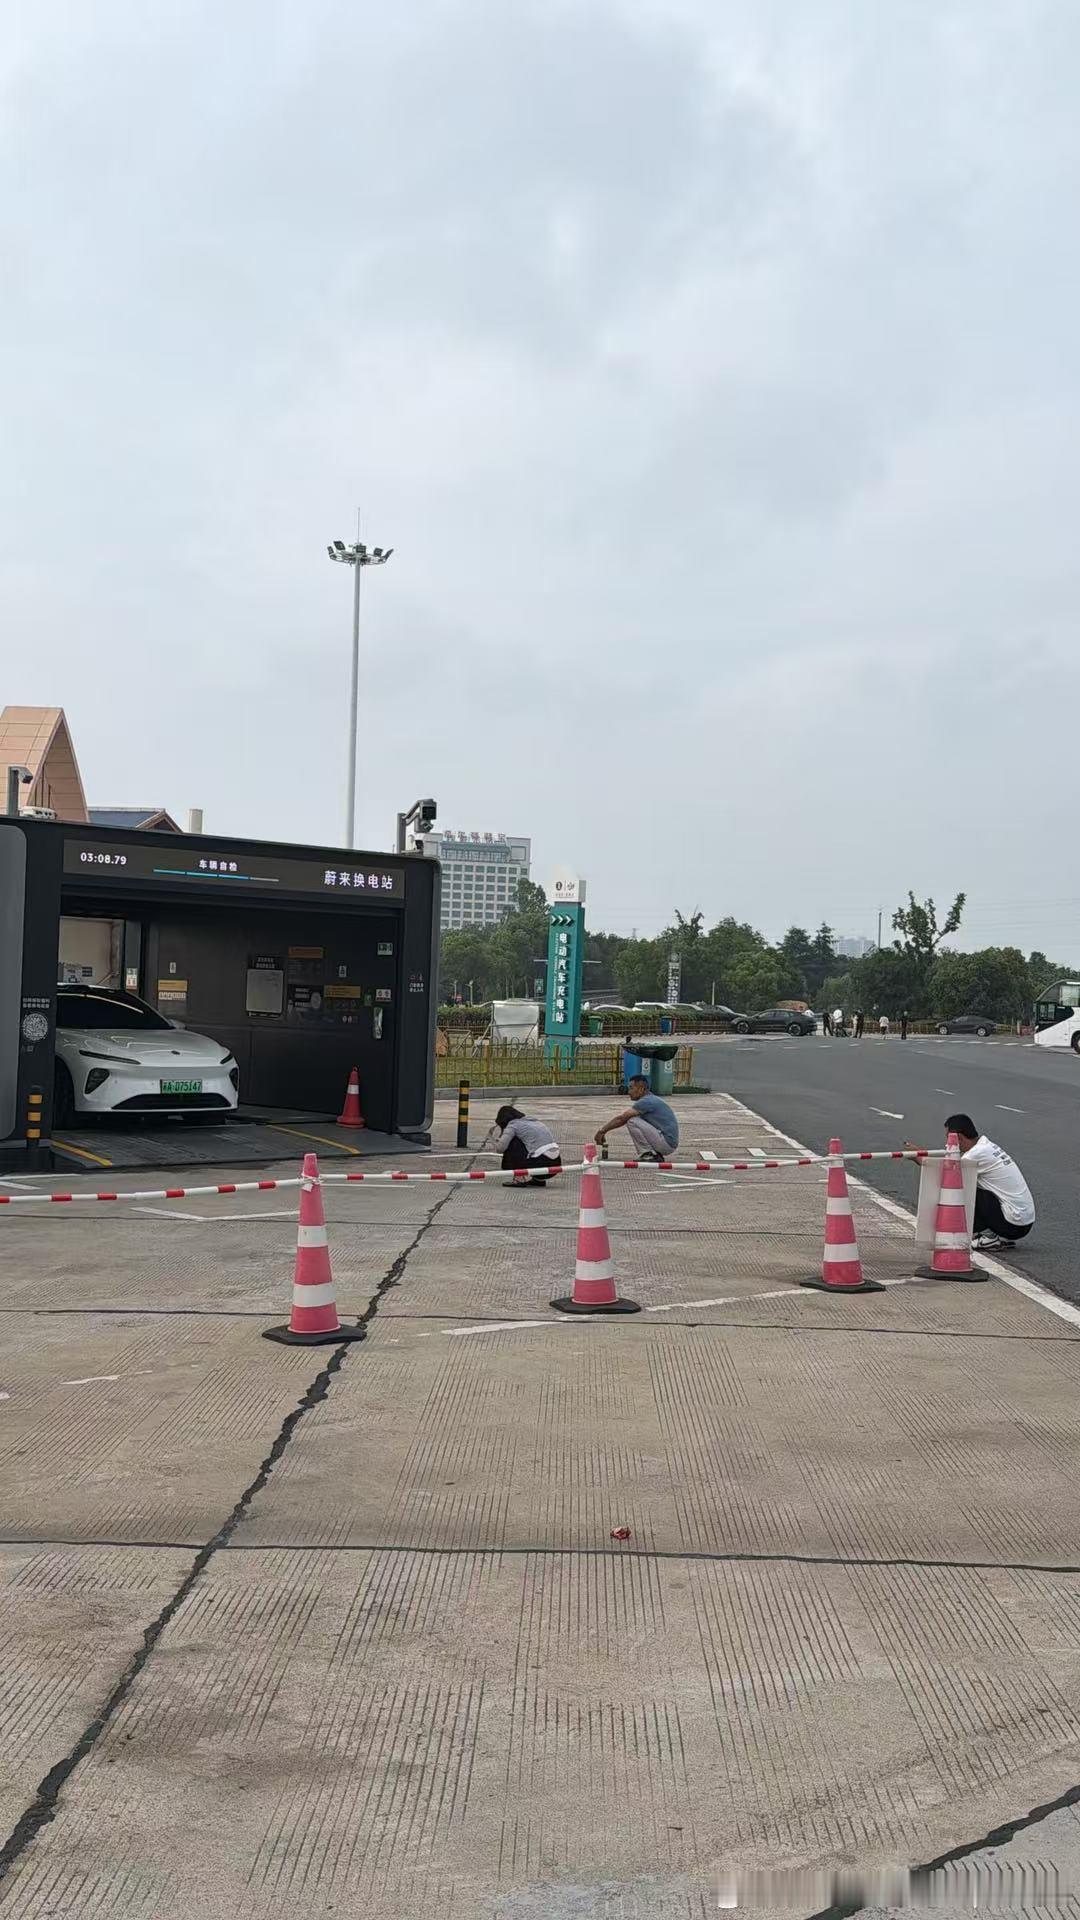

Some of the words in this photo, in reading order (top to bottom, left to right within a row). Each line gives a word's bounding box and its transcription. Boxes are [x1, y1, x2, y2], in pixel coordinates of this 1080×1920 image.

[80, 852, 127, 866] 03:08.79
[199, 859, 238, 872] 车辆自检
[323, 870, 393, 890] 蔚来换电站
[556, 933, 568, 1023] 电动汽车充电站
